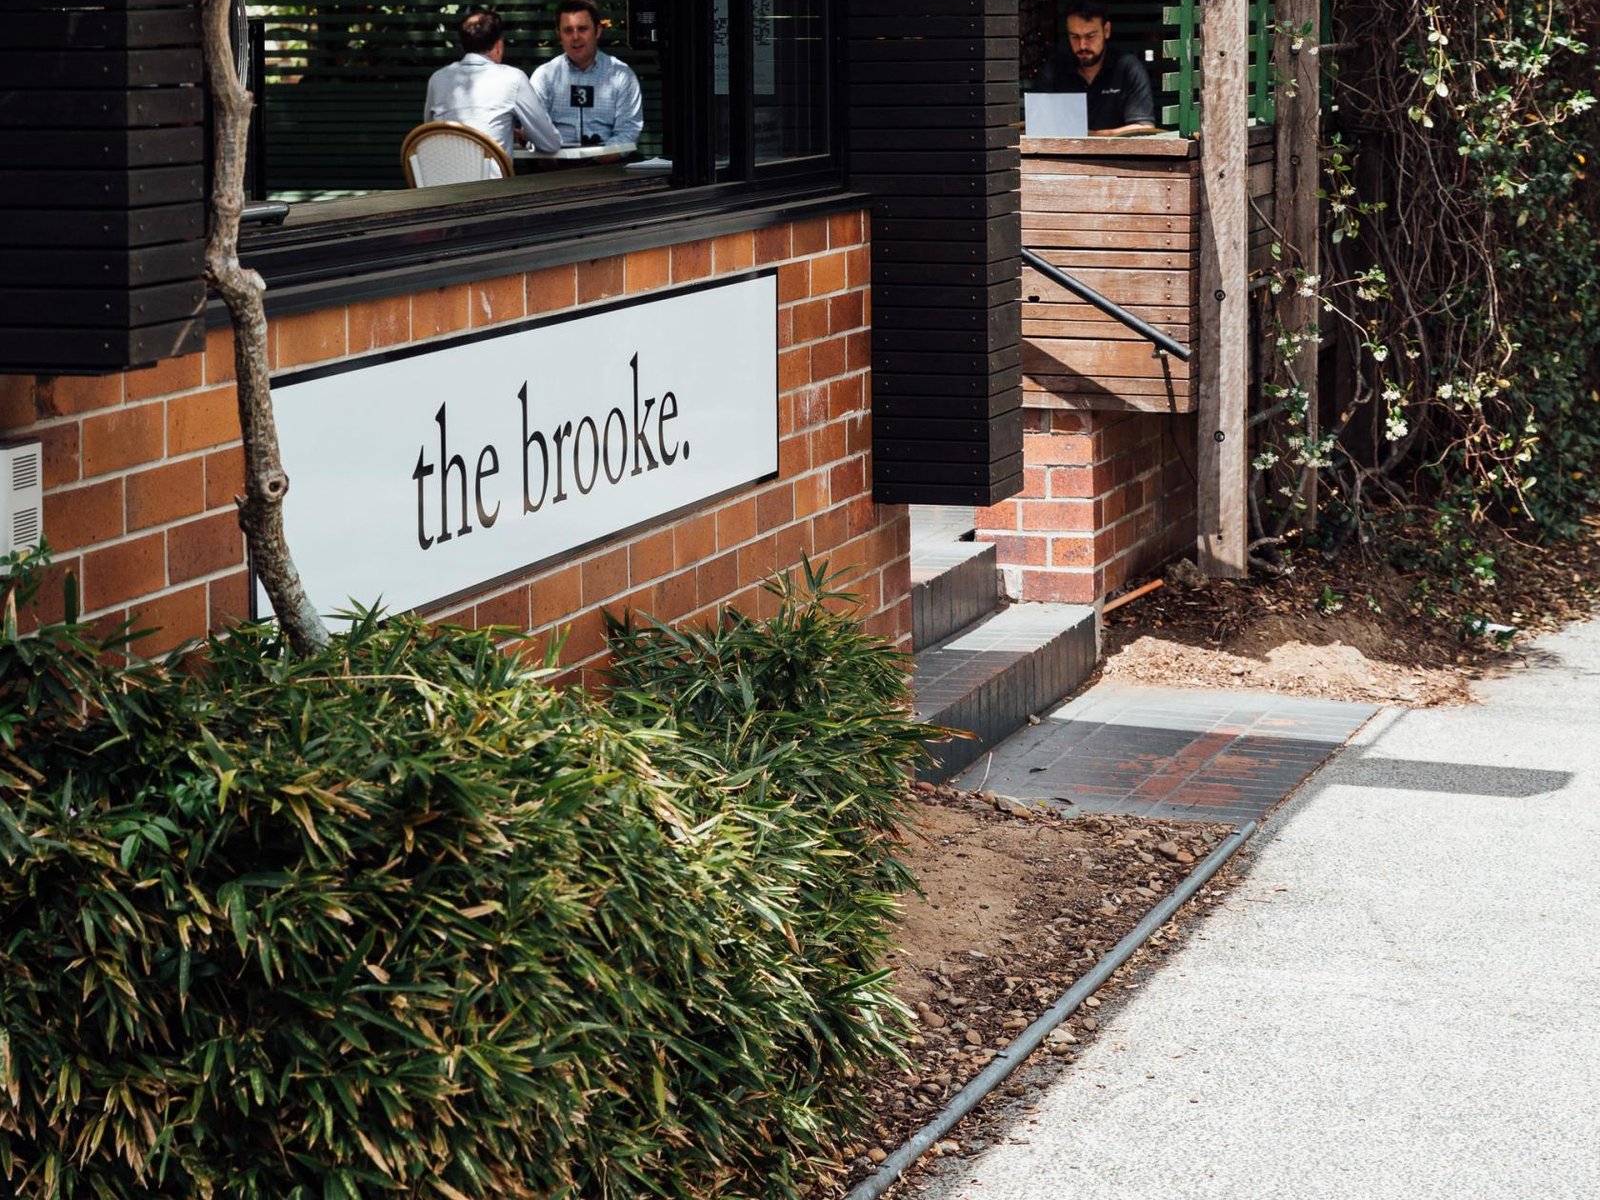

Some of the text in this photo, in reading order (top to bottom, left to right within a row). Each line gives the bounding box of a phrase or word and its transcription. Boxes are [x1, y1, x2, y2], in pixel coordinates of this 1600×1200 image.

[578, 88, 587, 105] 3
[412, 351, 691, 551] the brooke.
